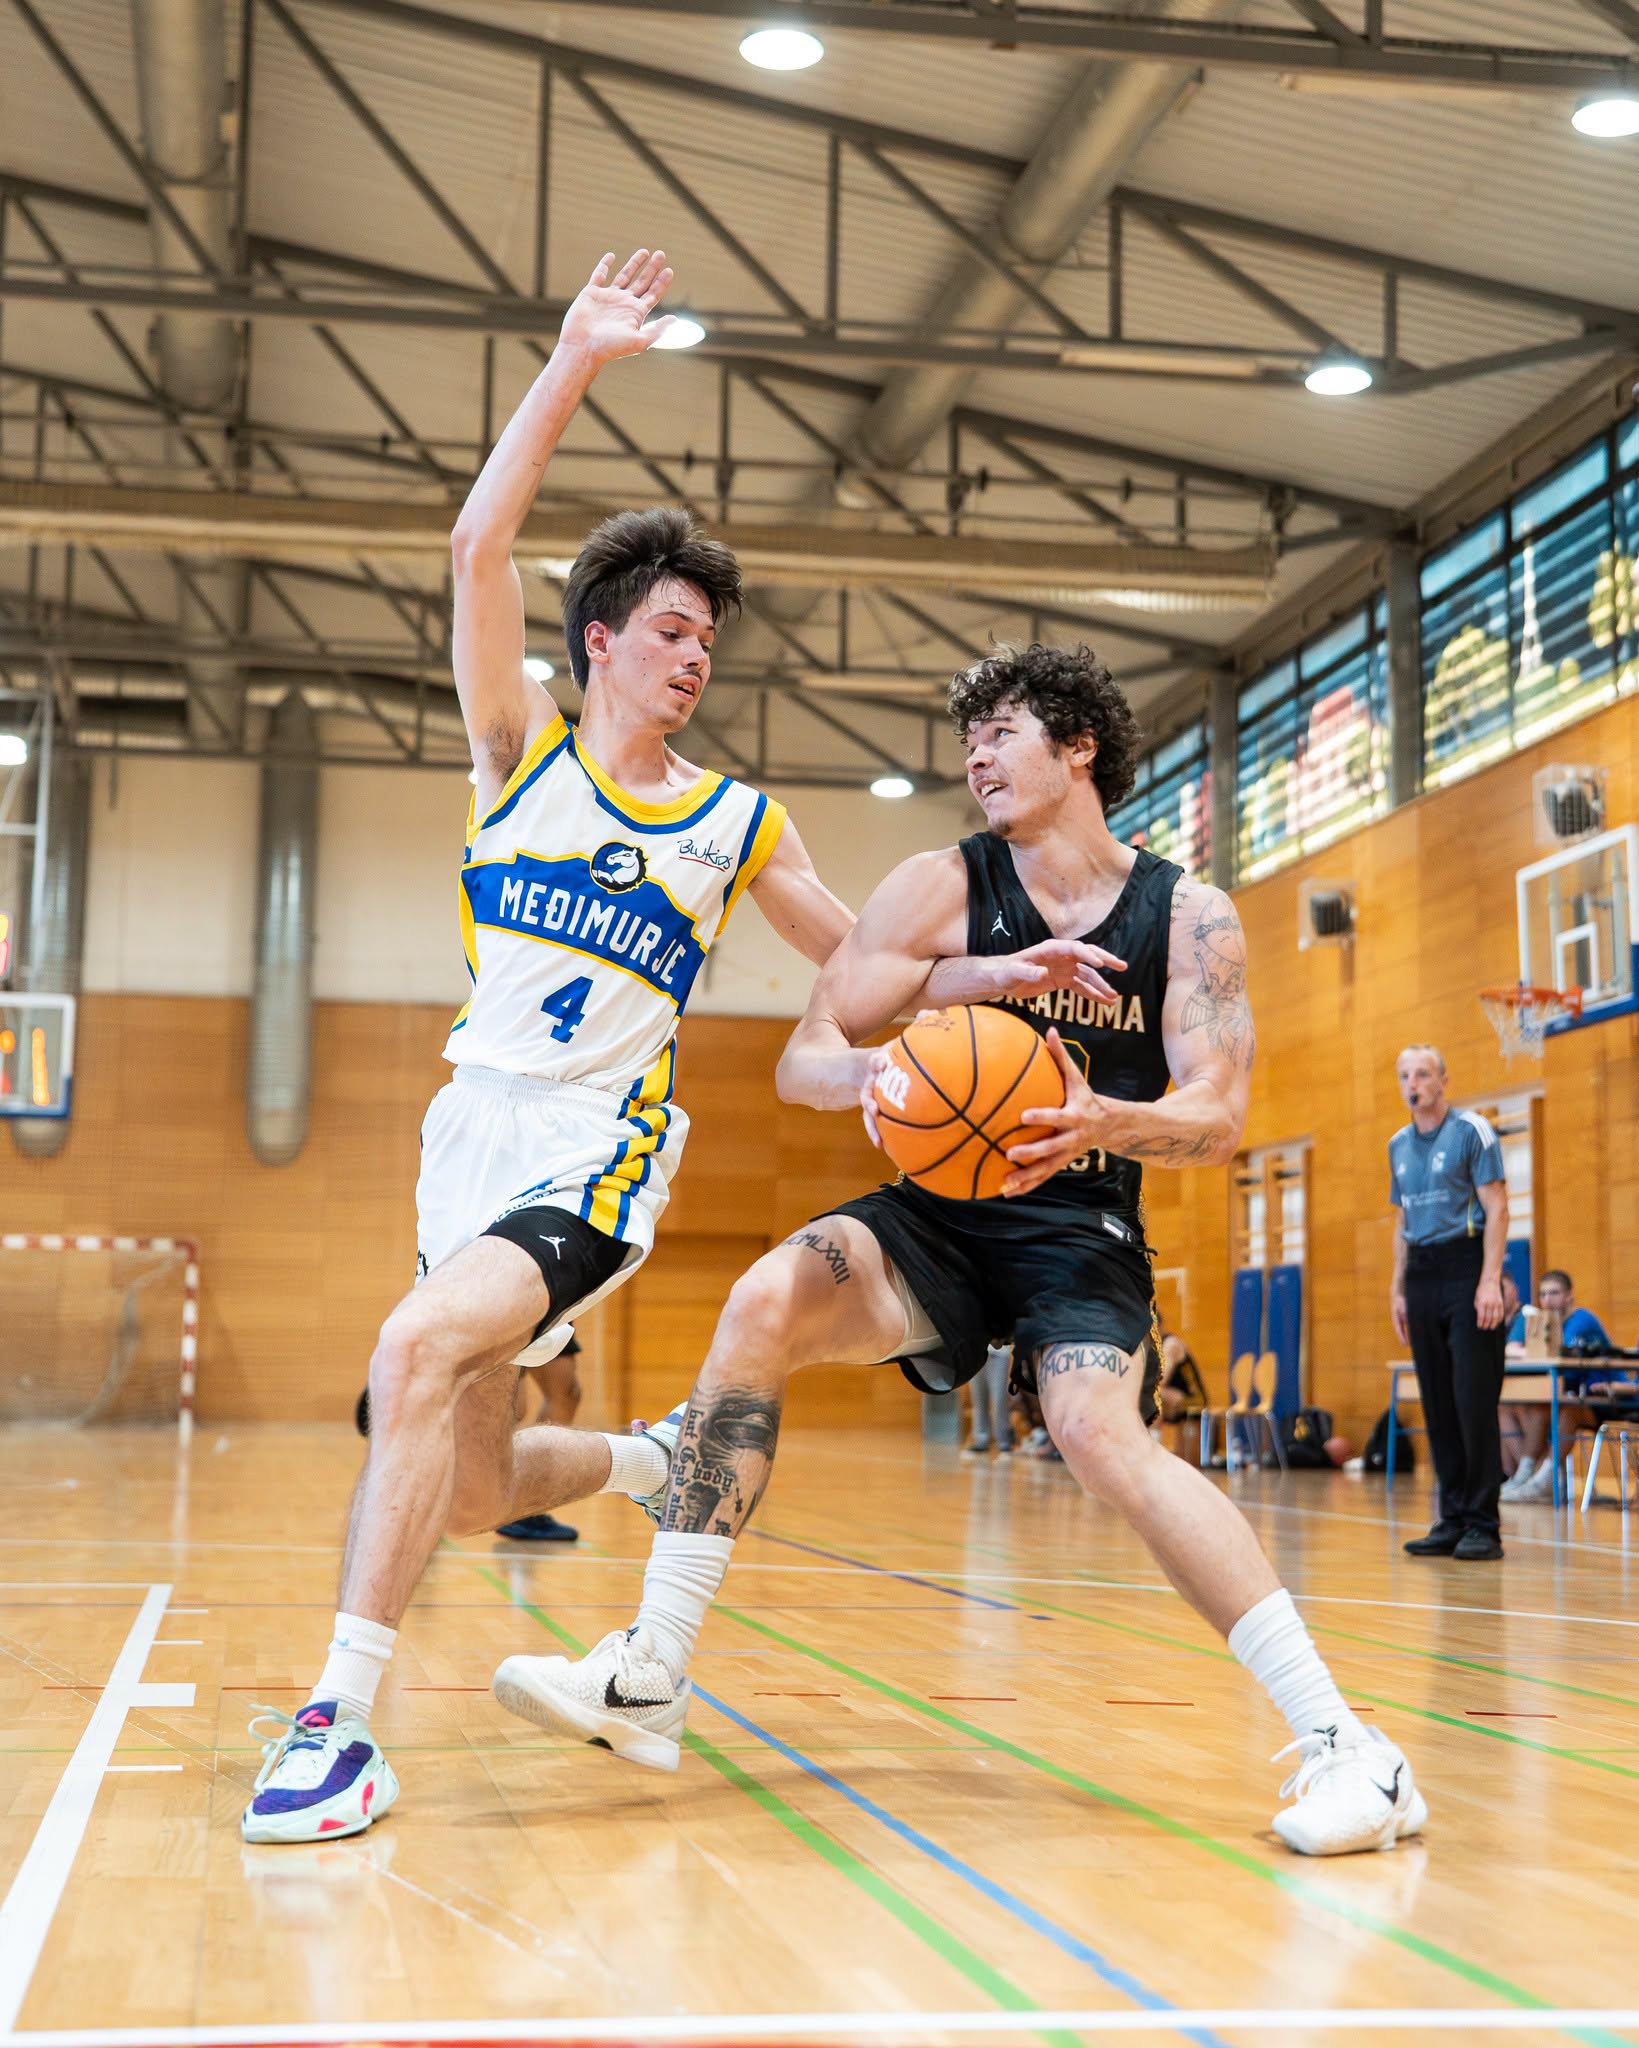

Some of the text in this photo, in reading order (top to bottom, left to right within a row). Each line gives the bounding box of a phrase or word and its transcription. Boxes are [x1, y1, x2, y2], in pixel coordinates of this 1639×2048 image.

[499, 876, 687, 985] MEĐIMURJE
[540, 975, 594, 1044] 4
[988, 987, 1145, 1033] AHOMA
